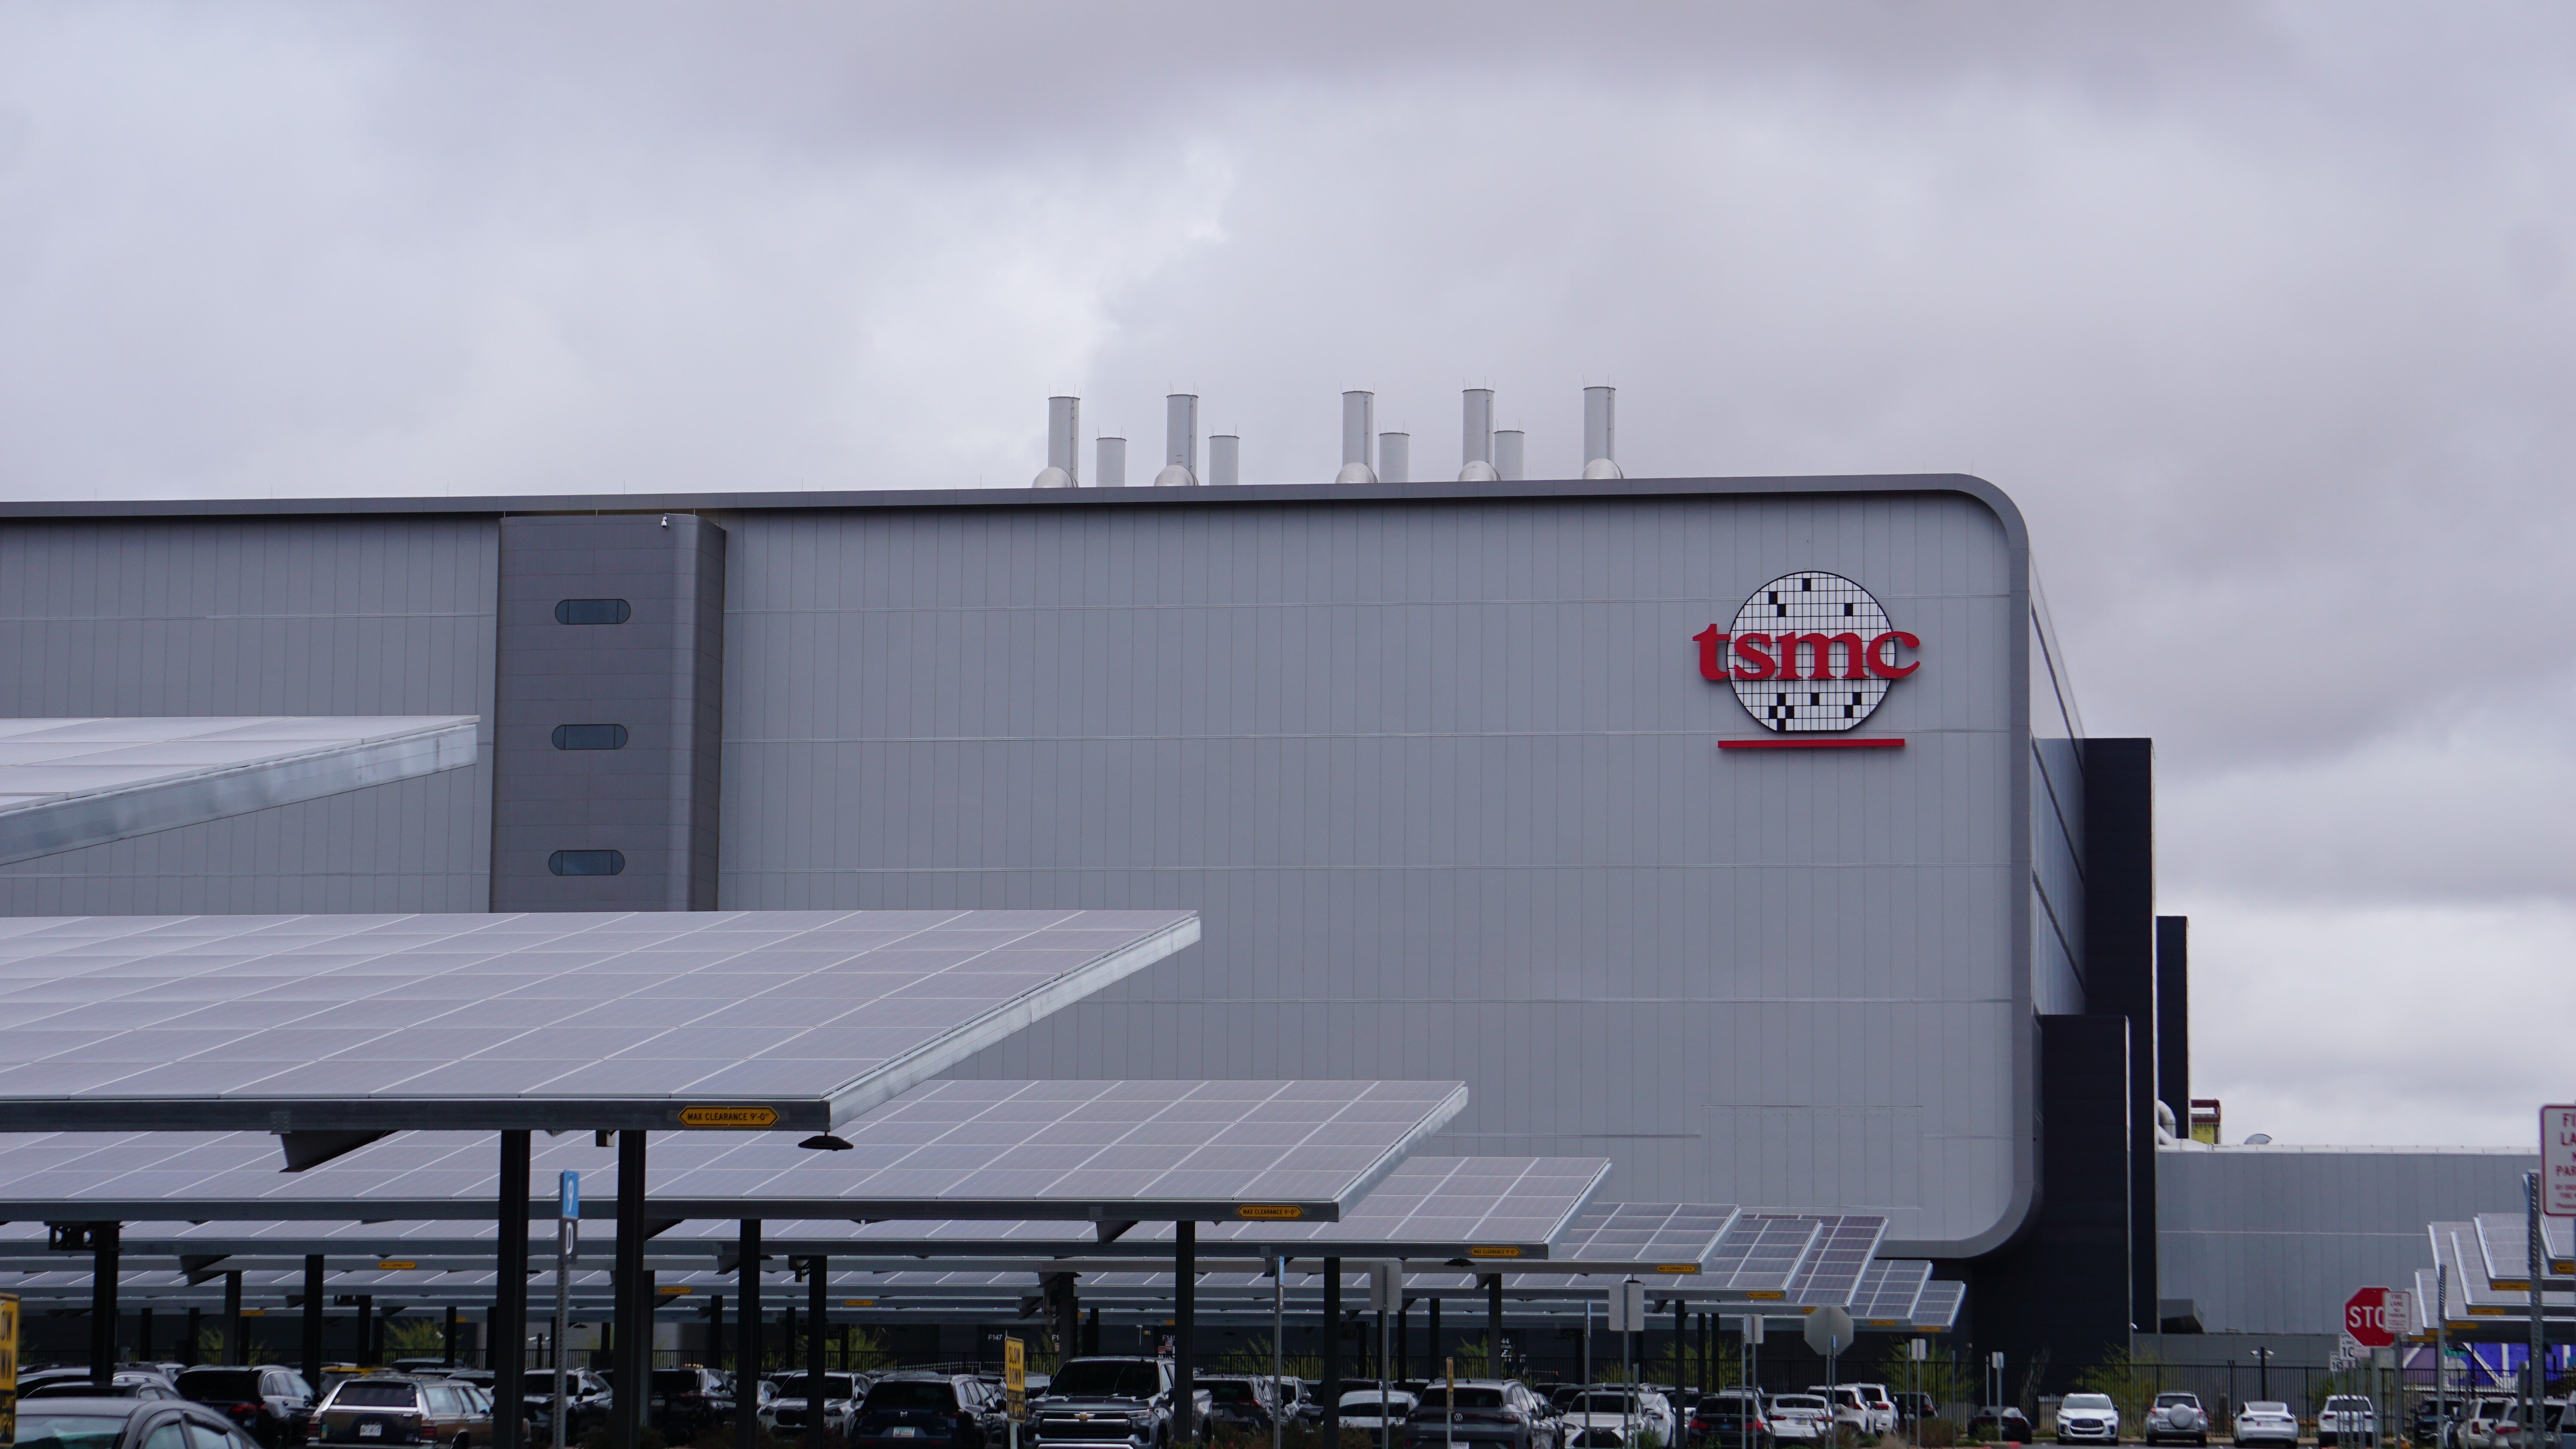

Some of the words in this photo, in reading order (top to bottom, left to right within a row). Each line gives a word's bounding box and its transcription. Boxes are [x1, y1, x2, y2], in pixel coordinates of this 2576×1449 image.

[1692, 624, 1920, 680] tsmc
[2563, 1113, 2576, 1127] FI
[567, 1179, 574, 1212] 9
[565, 1222, 574, 1255] D
[2348, 1306, 2384, 1328] STO
[1009, 1346, 1021, 1364] SLOW
[1009, 1367, 1021, 1385] DOWN
